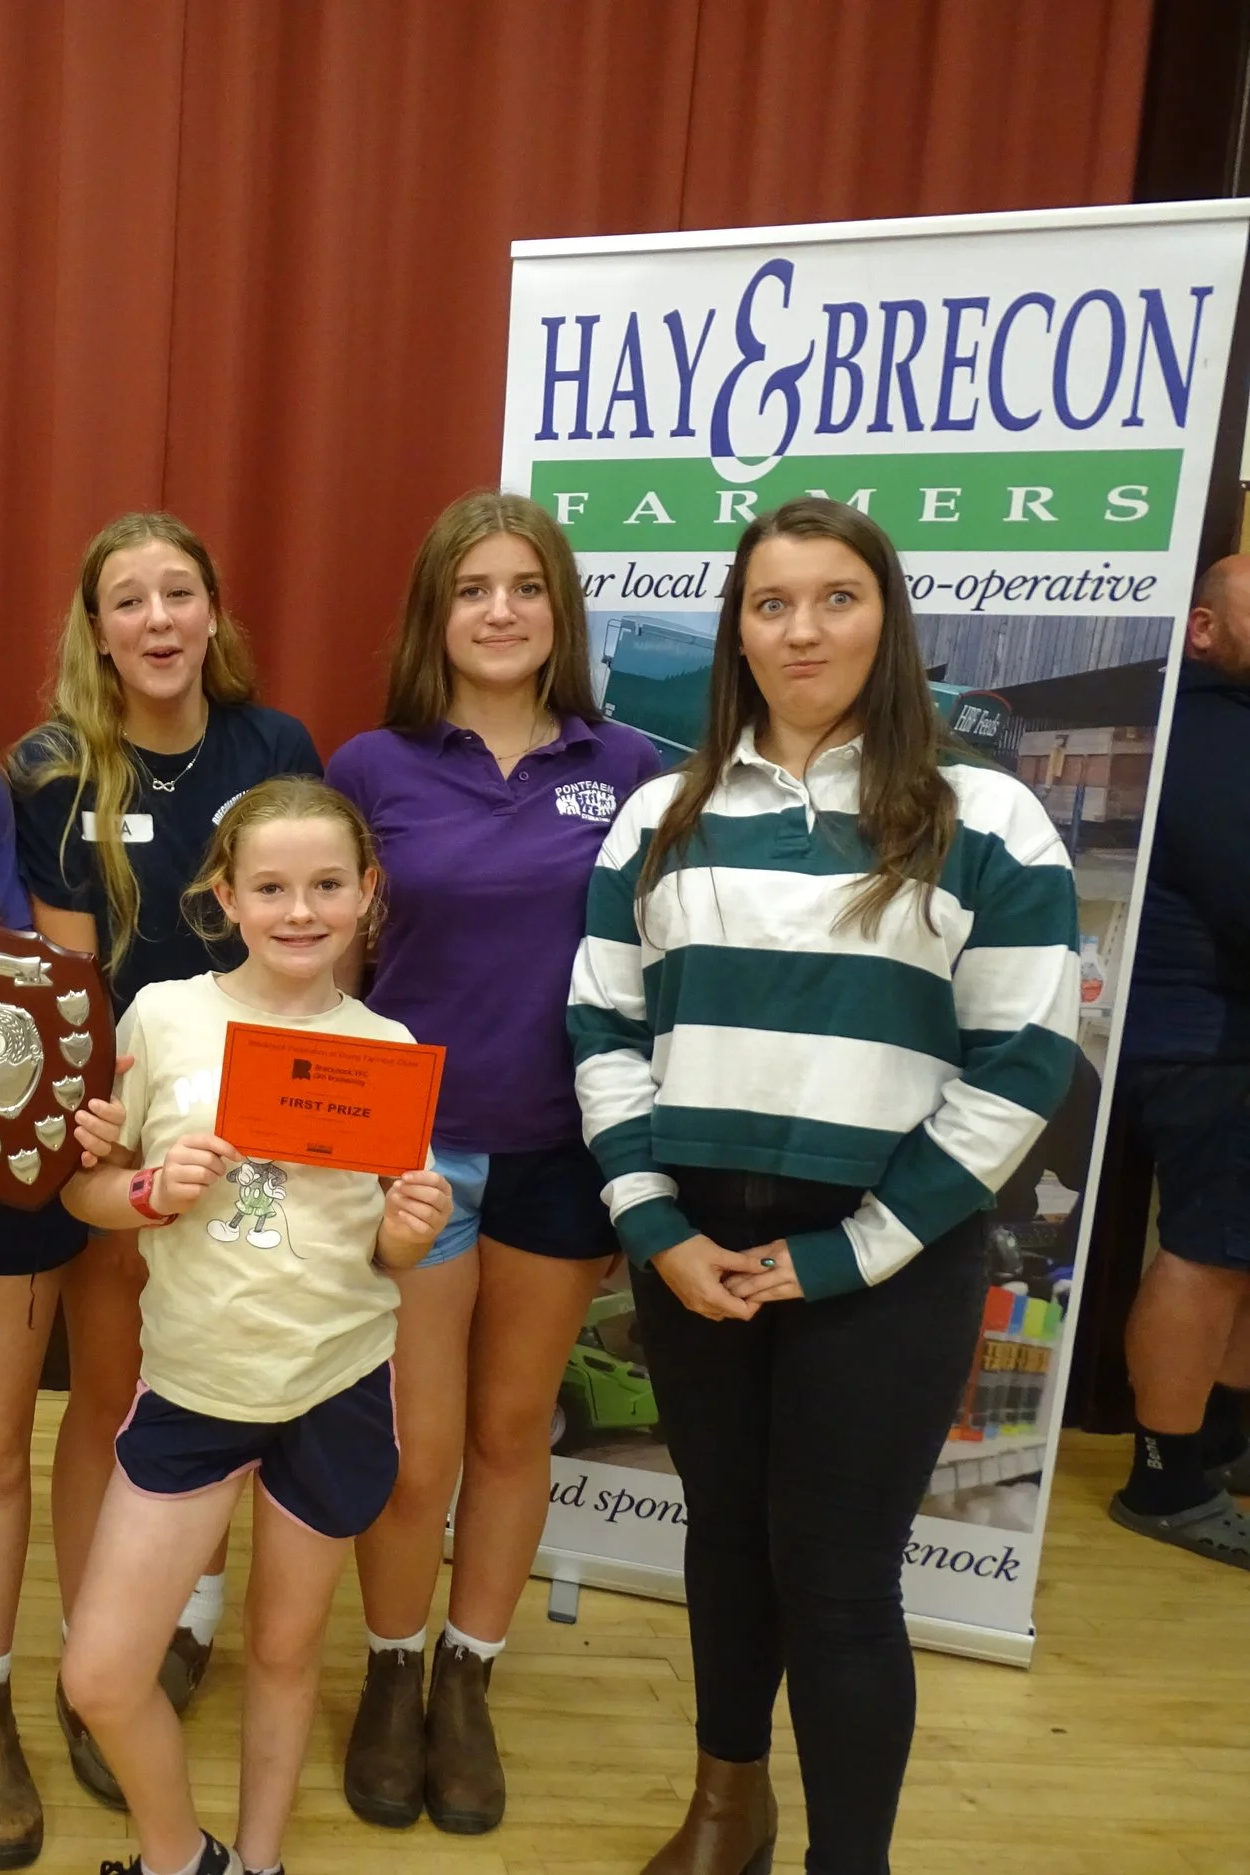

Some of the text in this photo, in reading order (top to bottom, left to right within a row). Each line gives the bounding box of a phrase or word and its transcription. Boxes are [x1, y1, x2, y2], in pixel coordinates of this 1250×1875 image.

[620, 561, 711, 599] local
[554, 780, 615, 797] PONTFAEN
[279, 1096, 324, 1112] FIRST
[327, 1103, 372, 1118] PRIZE
[593, 1488, 689, 1526] spon
